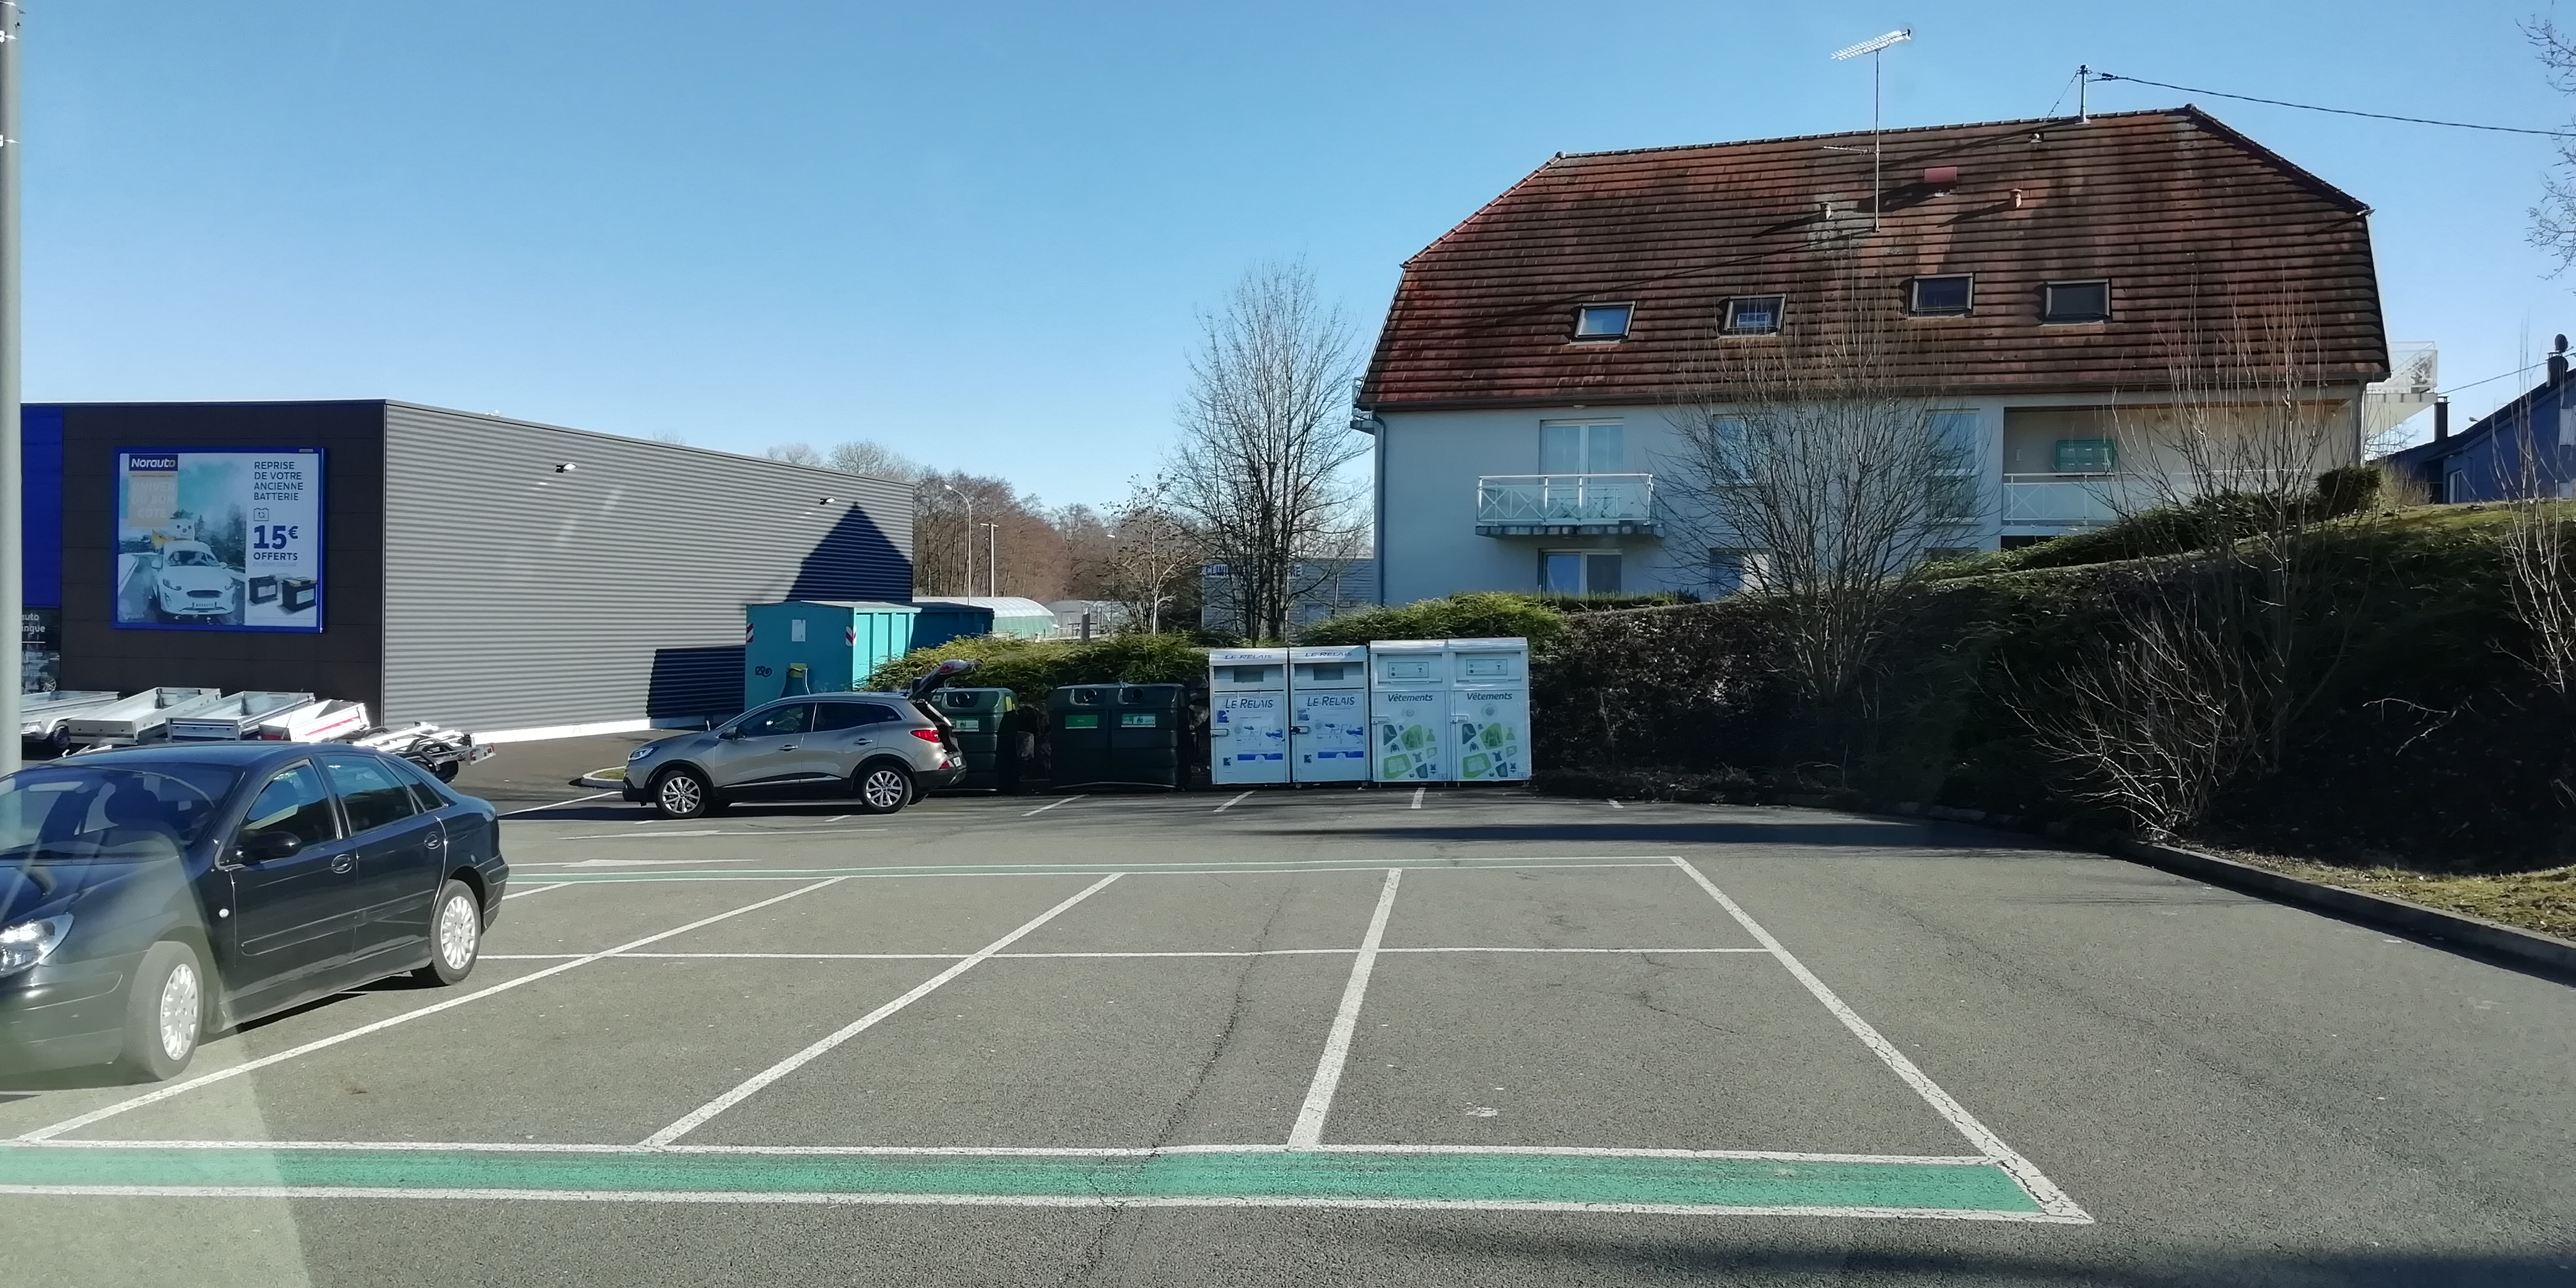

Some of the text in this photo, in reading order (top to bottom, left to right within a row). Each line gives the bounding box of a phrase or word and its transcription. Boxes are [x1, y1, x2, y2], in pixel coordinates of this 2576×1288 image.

[131, 458, 176, 468] Norauto
[254, 461, 295, 469] REPRISE
[254, 472, 302, 480] DE VOTRE
[254, 482, 303, 490] ANCIENNE
[254, 492, 299, 501] BATTERIE
[253, 525, 299, 550] 15€
[253, 552, 298, 560] OFFERTS
[1388, 694, 1434, 702] Vêtements
[1467, 692, 1513, 700] Vêtements
[1225, 698, 1274, 709] LE RELAIS
[1307, 695, 1355, 707] LE RELAIS
